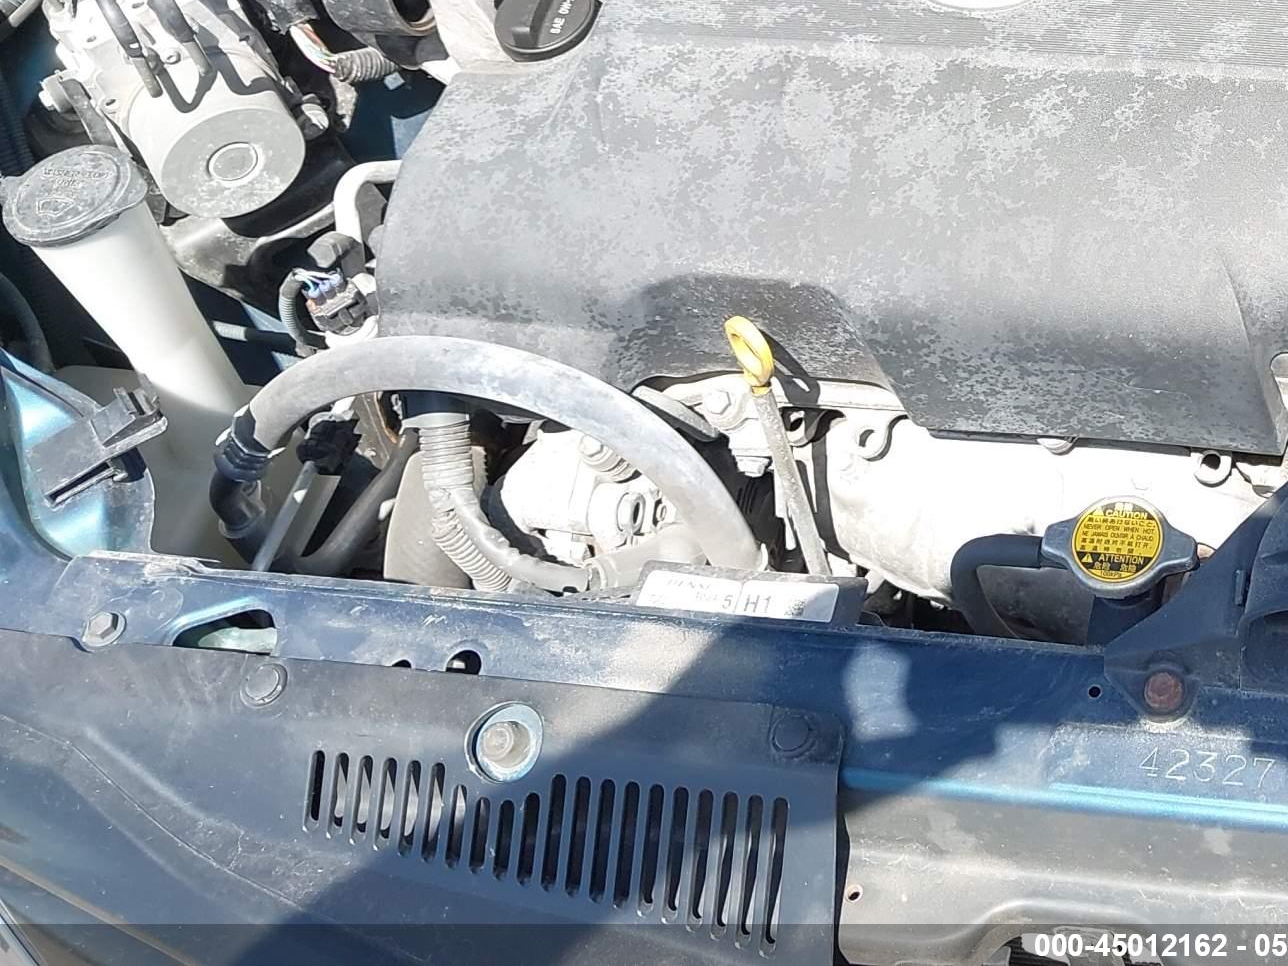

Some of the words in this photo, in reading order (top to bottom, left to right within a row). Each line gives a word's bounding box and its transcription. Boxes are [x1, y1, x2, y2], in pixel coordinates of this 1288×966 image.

[1106, 510, 1148, 519] CAUTION
[1098, 554, 1144, 564] ATTENTION
[744, 595, 772, 614] H1
[1138, 746, 1276, 789] 42327
